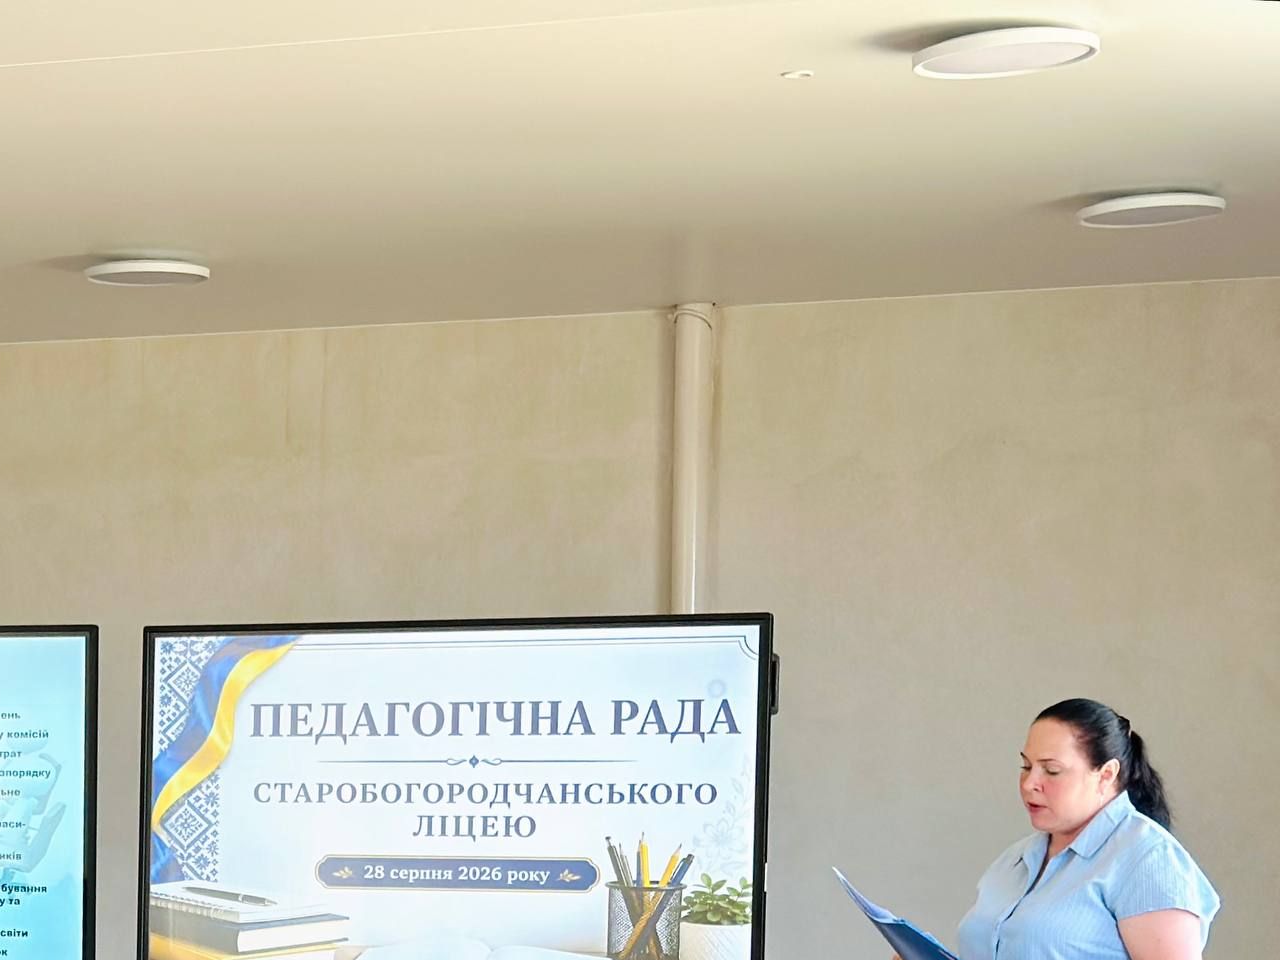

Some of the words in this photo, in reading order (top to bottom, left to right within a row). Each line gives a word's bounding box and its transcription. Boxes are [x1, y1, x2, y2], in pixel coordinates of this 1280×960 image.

[6, 729, 50, 738] комісій
[249, 700, 594, 745] ПЕДАГОГІЧНА
[610, 698, 742, 743] РАДА
[253, 782, 718, 808] СТАРОБОГОРОДЧАНСЬКОГО
[412, 814, 537, 843] ЛІЦЕЮ
[363, 865, 385, 882] 28
[390, 869, 453, 885] серпня
[458, 865, 502, 882] 2026
[507, 868, 550, 886] року
